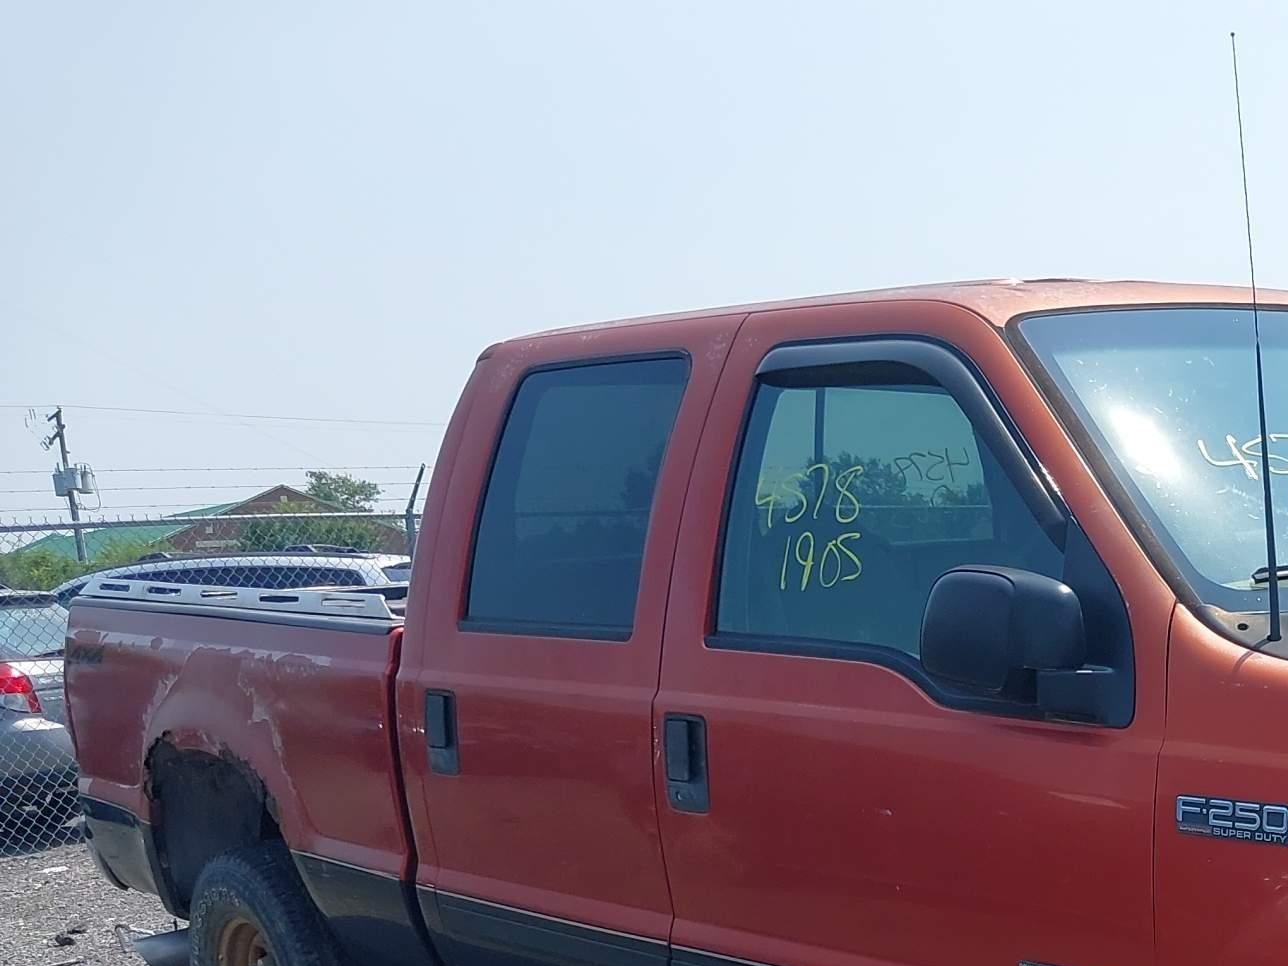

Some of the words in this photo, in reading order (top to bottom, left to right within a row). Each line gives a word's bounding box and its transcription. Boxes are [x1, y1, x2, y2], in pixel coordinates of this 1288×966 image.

[755, 463, 864, 528] 4578
[780, 531, 862, 591] 1905
[1212, 827, 1251, 840] SUPER
[1254, 832, 1288, 844] DUTY
